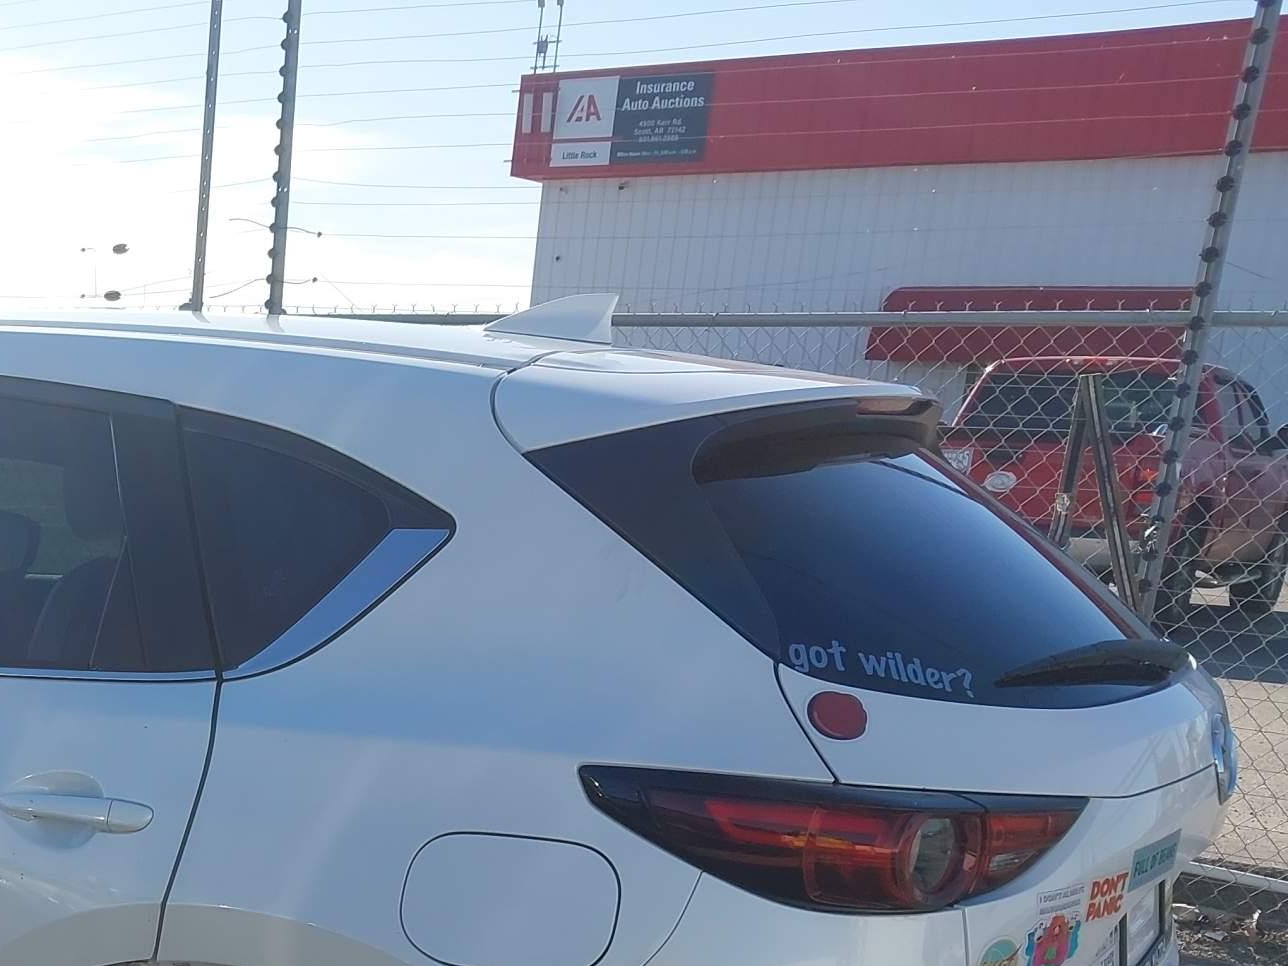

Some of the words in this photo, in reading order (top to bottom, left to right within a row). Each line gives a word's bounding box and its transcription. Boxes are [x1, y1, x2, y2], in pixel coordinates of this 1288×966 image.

[636, 80, 695, 95] Insurance
[621, 98, 649, 112] Auto
[651, 94, 705, 110] Auctions
[562, 152, 578, 160] Little
[580, 151, 597, 160] Rock
[789, 640, 846, 673] got
[858, 651, 975, 698] wilder?
[1091, 872, 1129, 900] DON'T
[1086, 895, 1123, 922] PANIC
